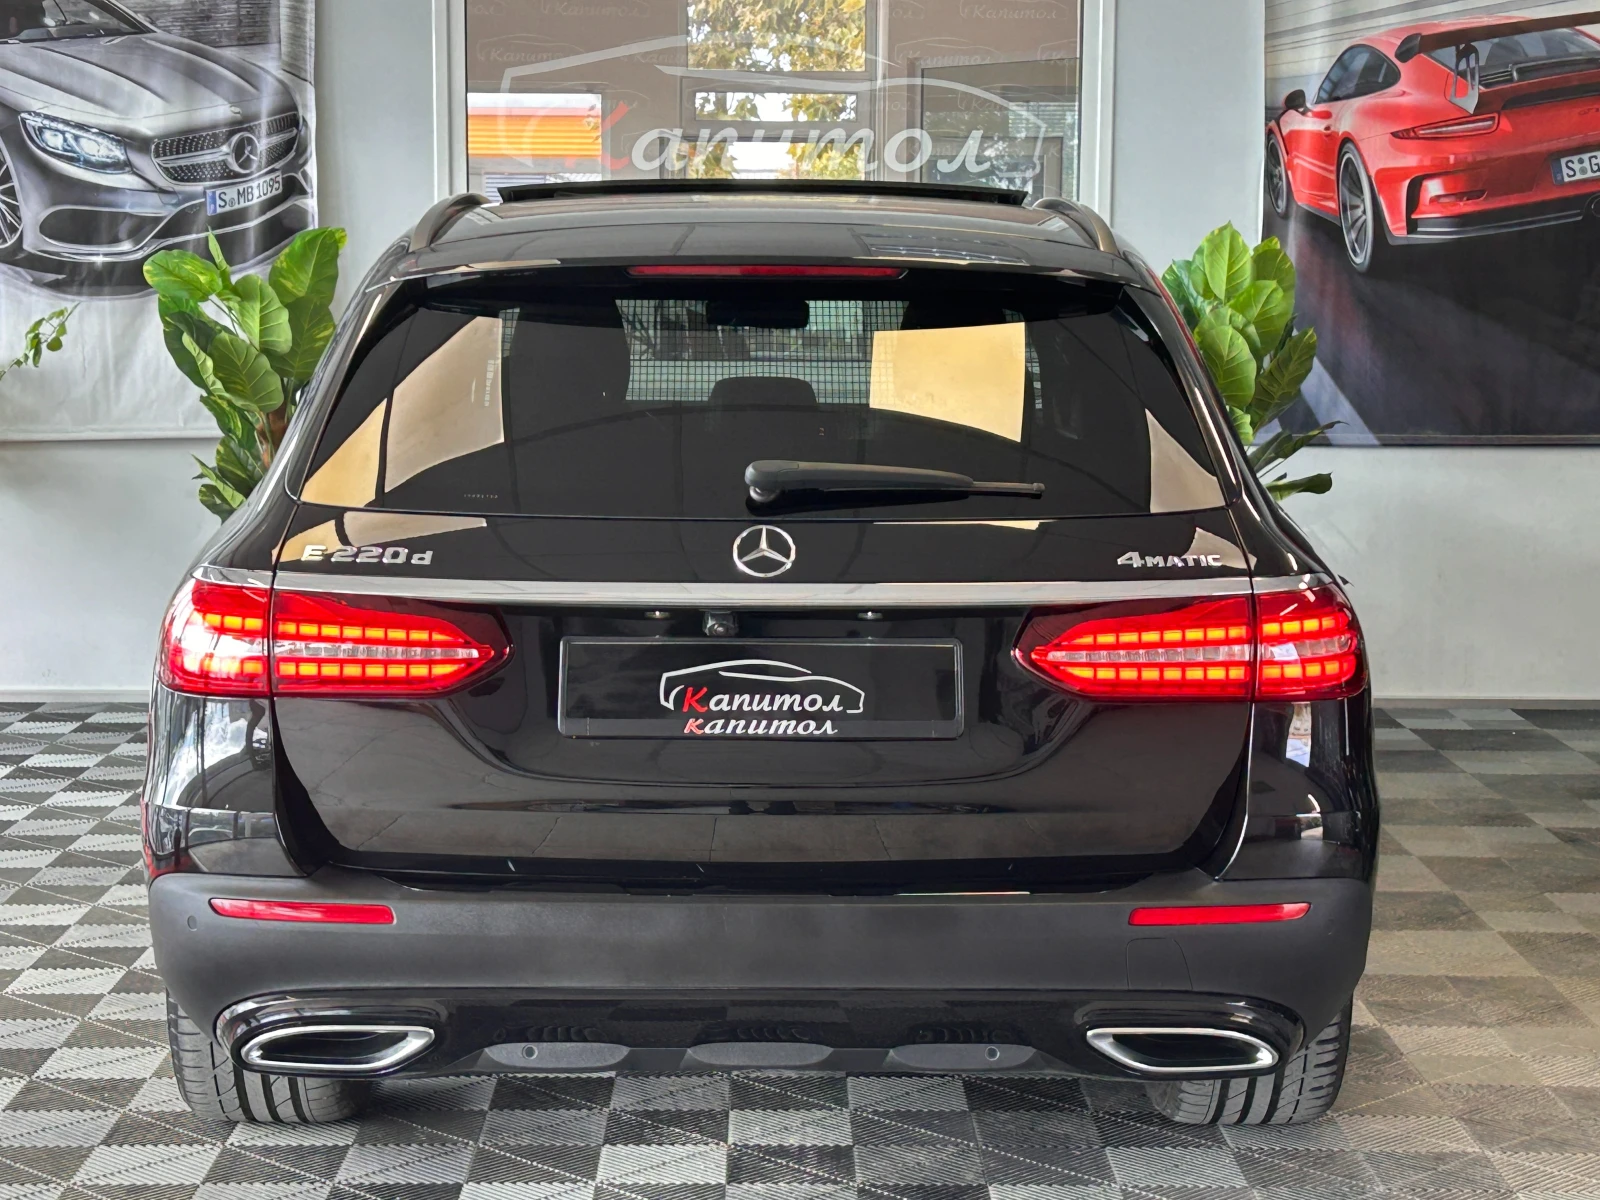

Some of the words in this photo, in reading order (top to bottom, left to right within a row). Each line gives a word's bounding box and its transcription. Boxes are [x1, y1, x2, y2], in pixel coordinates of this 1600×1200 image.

[1565, 160, 1576, 178] S
[218, 191, 228, 209] S
[237, 185, 254, 205] MB
[256, 175, 280, 199] 1095
[301, 544, 327, 561] E
[1117, 551, 1223, 568] 4MATIC
[682, 686, 844, 713] Капитол
